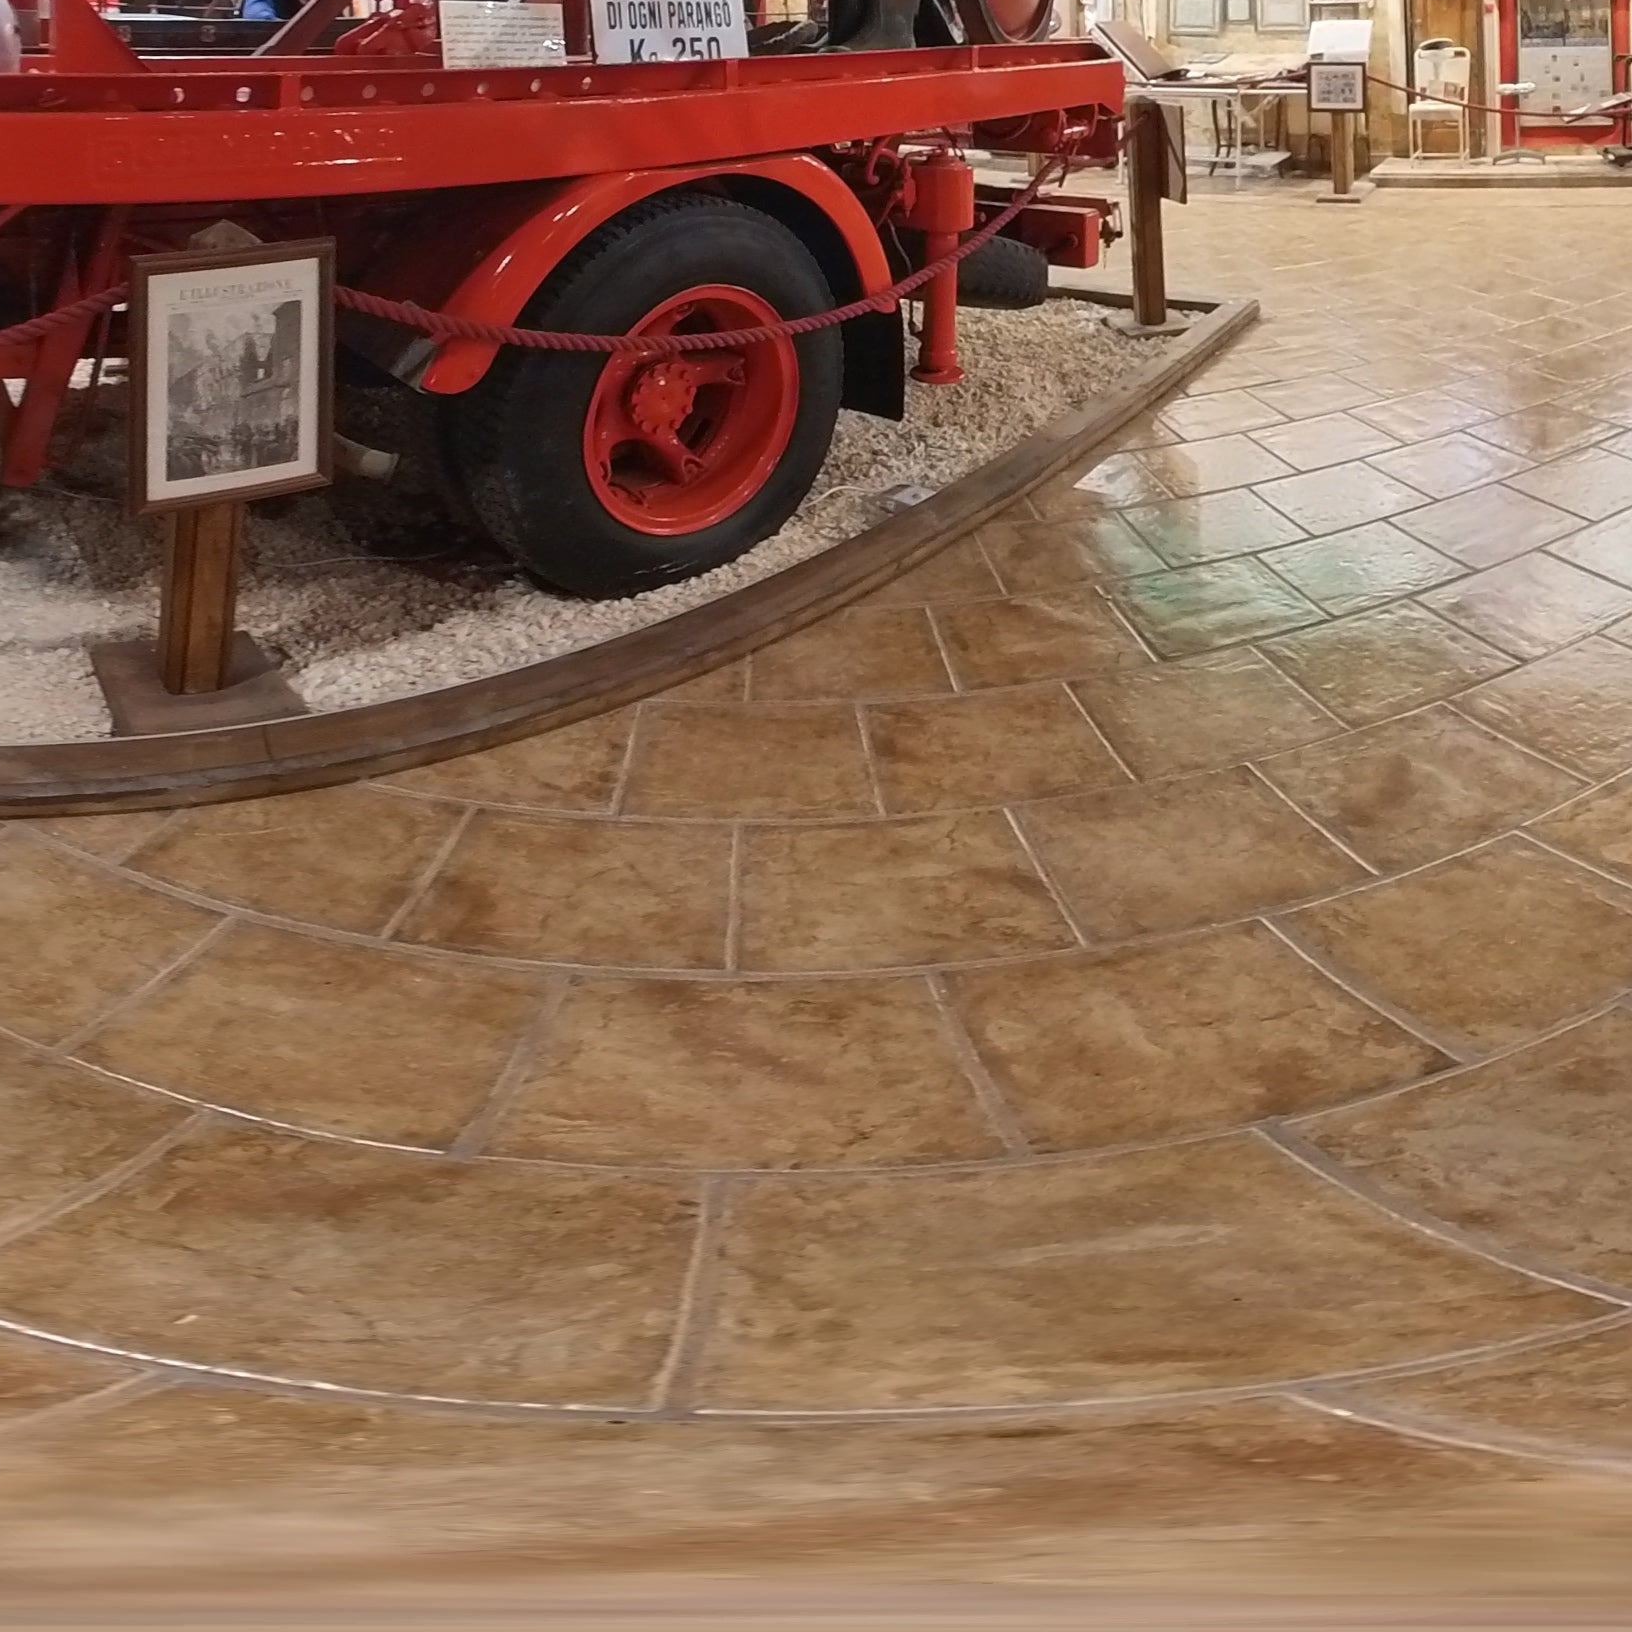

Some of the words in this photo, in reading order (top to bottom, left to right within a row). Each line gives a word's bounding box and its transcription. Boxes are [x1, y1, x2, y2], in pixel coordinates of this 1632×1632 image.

[607, 1, 622, 30] DI
[628, 1, 662, 29] OGNI
[672, 36, 722, 62] 250
